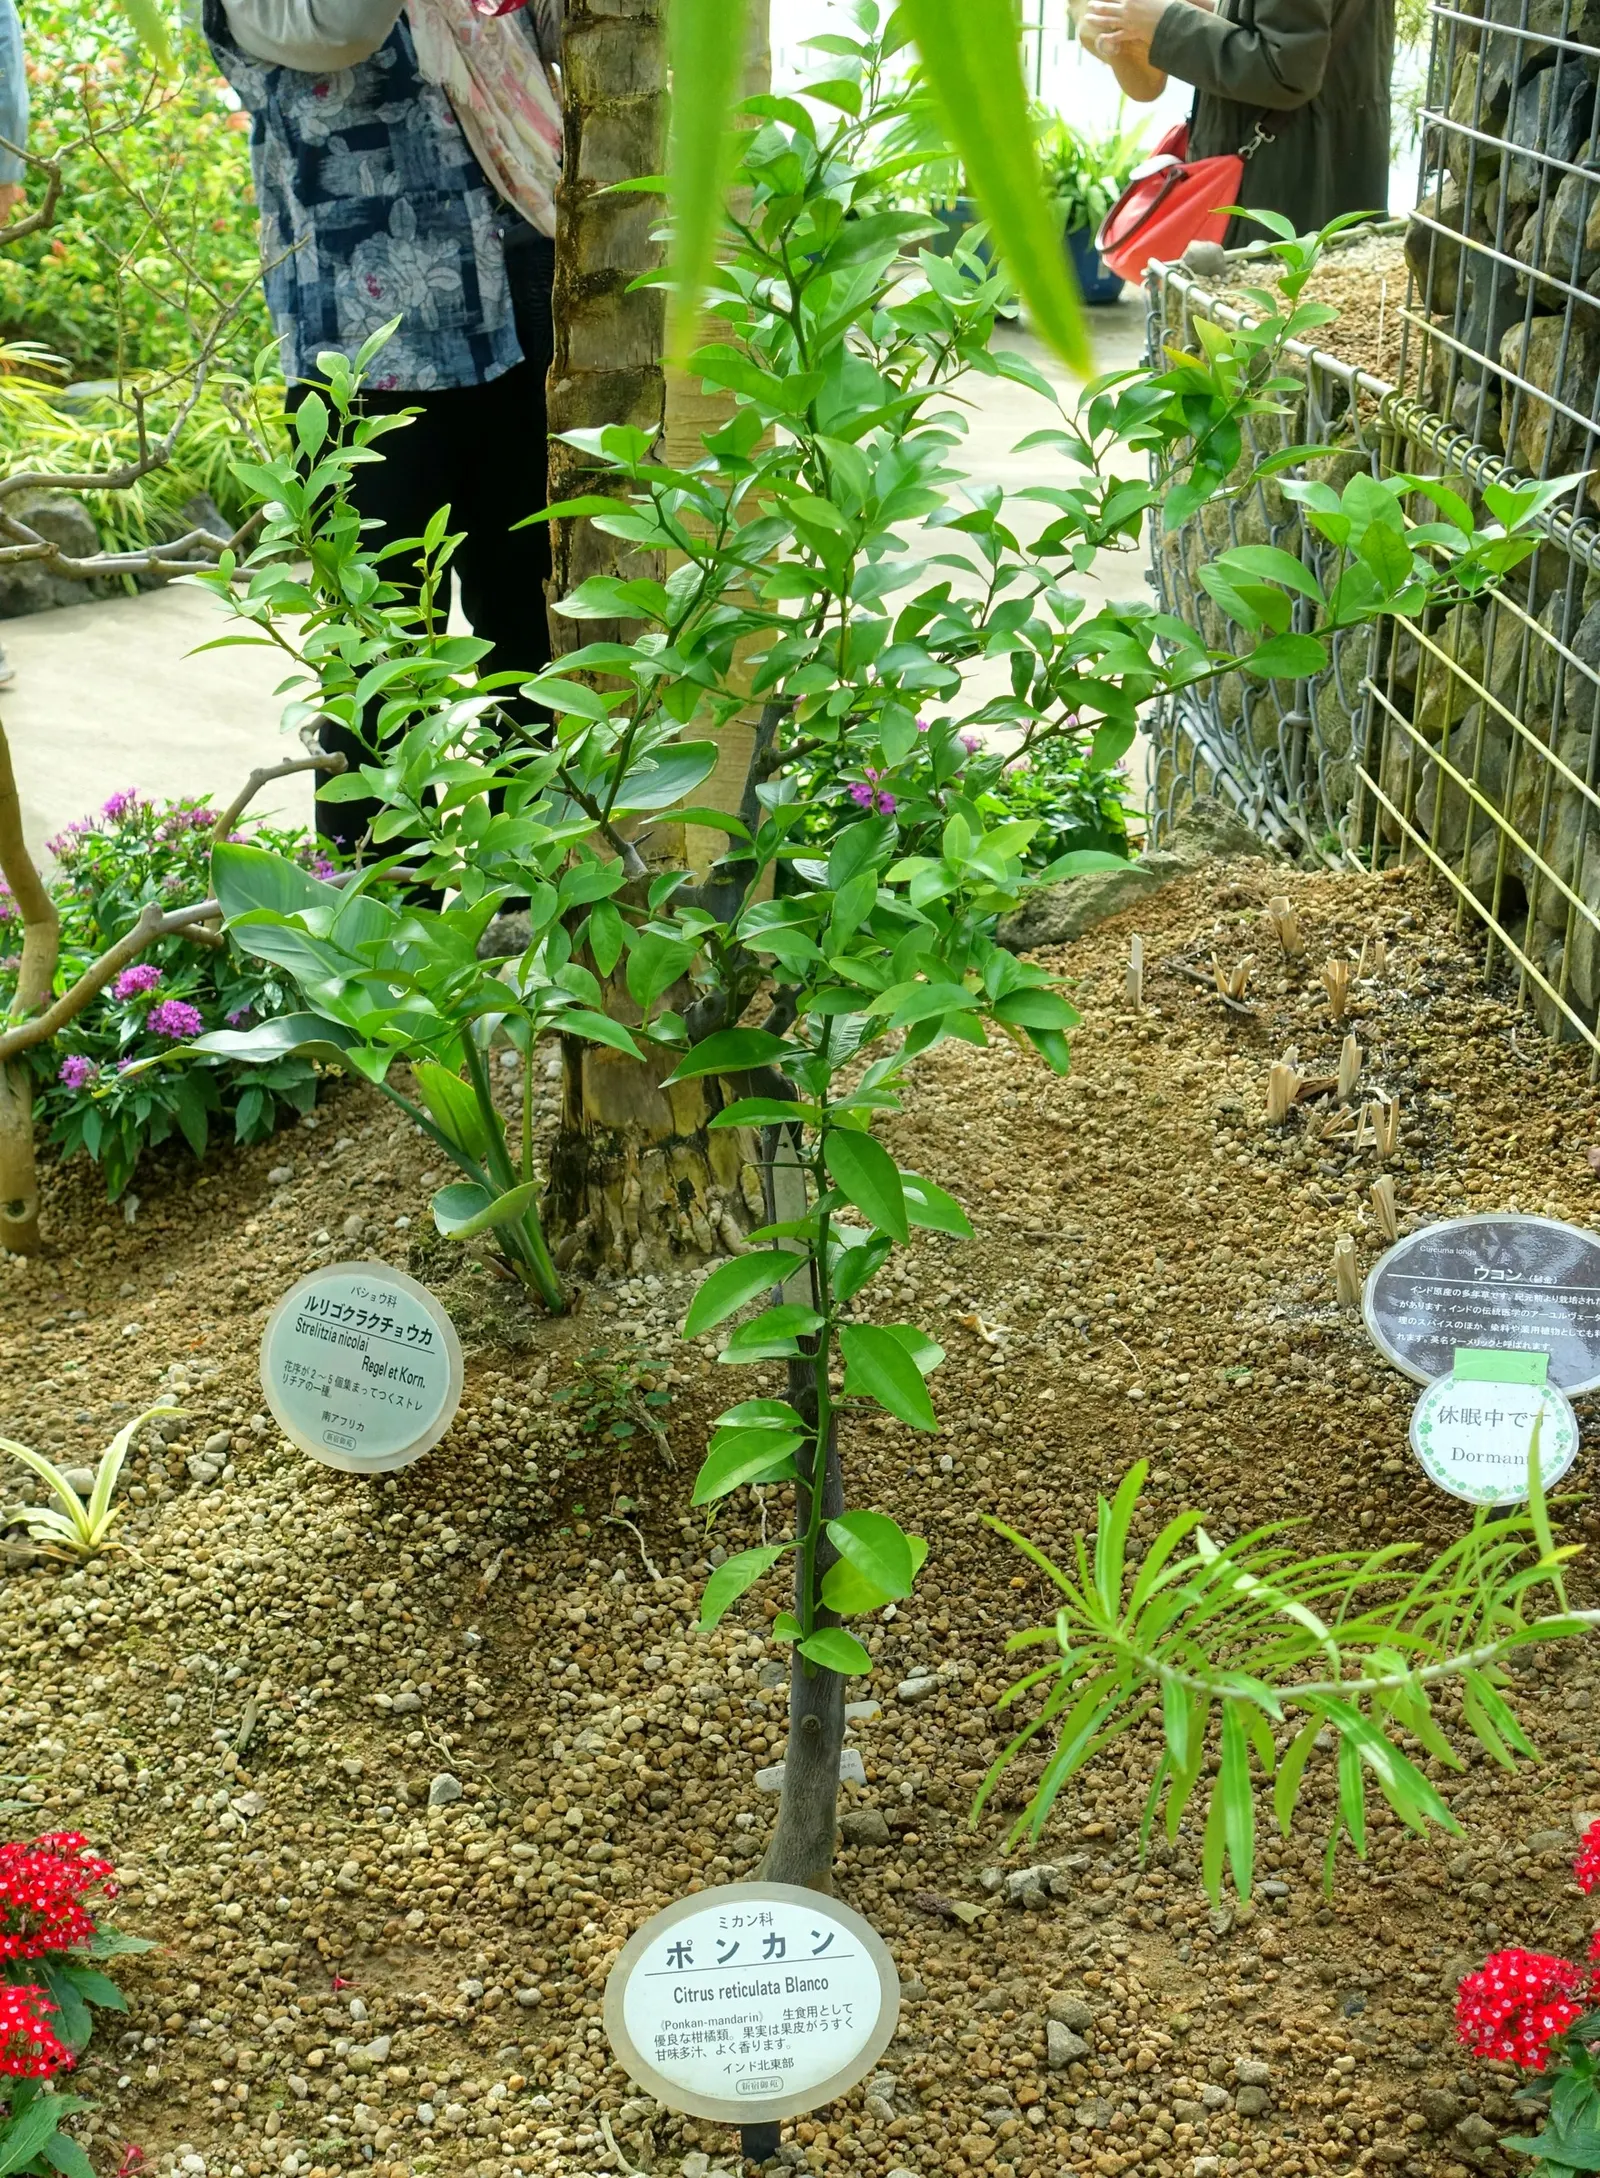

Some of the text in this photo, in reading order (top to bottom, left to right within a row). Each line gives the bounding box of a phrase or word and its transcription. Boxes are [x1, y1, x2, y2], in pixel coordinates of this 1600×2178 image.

[1419, 1245, 1477, 1256] Curcuma longa
[1473, 1265, 1522, 1282] ウコン
[351, 1286, 398, 1309] バショウ科
[304, 1295, 433, 1346] ルリゴクラクチョウカ
[295, 1317, 370, 1352] Strelitzia nicolai
[361, 1355, 426, 1389] Regel et Korn.
[321, 1410, 365, 1432] 南アフリカ
[1451, 1447, 1531, 1466] Dorman
[719, 1911, 774, 1930] ミカン科
[666, 1929, 835, 1969] ポンカン
[673, 1975, 829, 2004] Citrus reticulata Blanco
[782, 2003, 854, 2021] 生食用として
[722, 2057, 795, 2075] インド北東部
